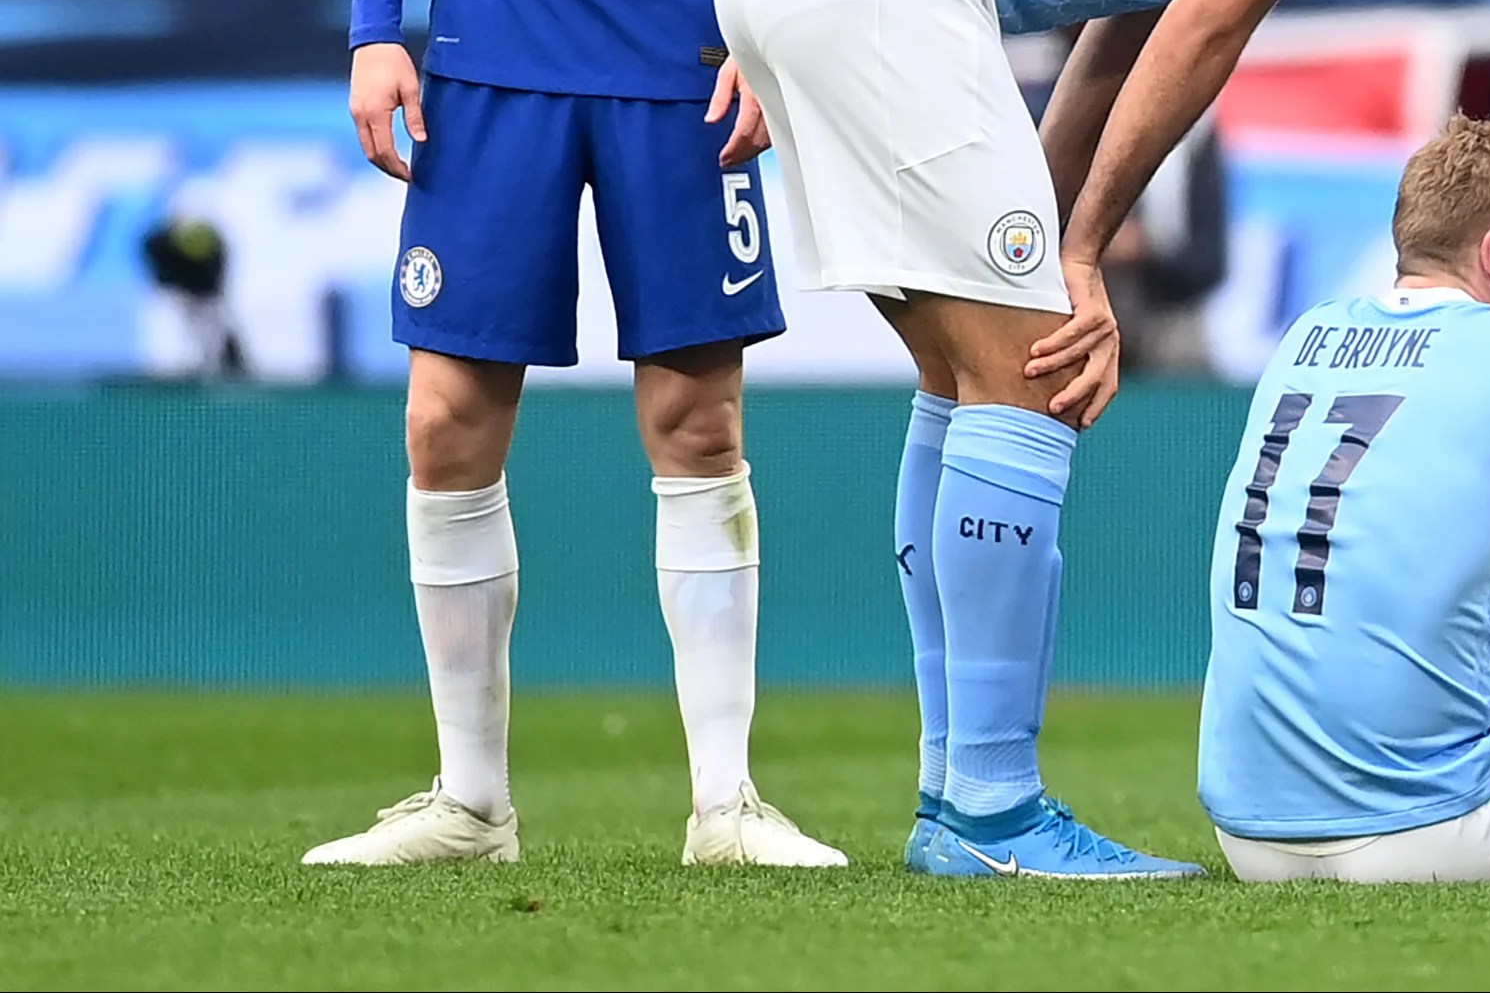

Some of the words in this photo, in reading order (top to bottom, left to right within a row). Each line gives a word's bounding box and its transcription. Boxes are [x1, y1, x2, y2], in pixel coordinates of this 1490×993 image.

[721, 172, 761, 264] 5
[1293, 324, 1340, 367] DE
[1328, 326, 1442, 369] BRUYNE
[959, 515, 1034, 546] CITY
[1233, 392, 1407, 616] 17
